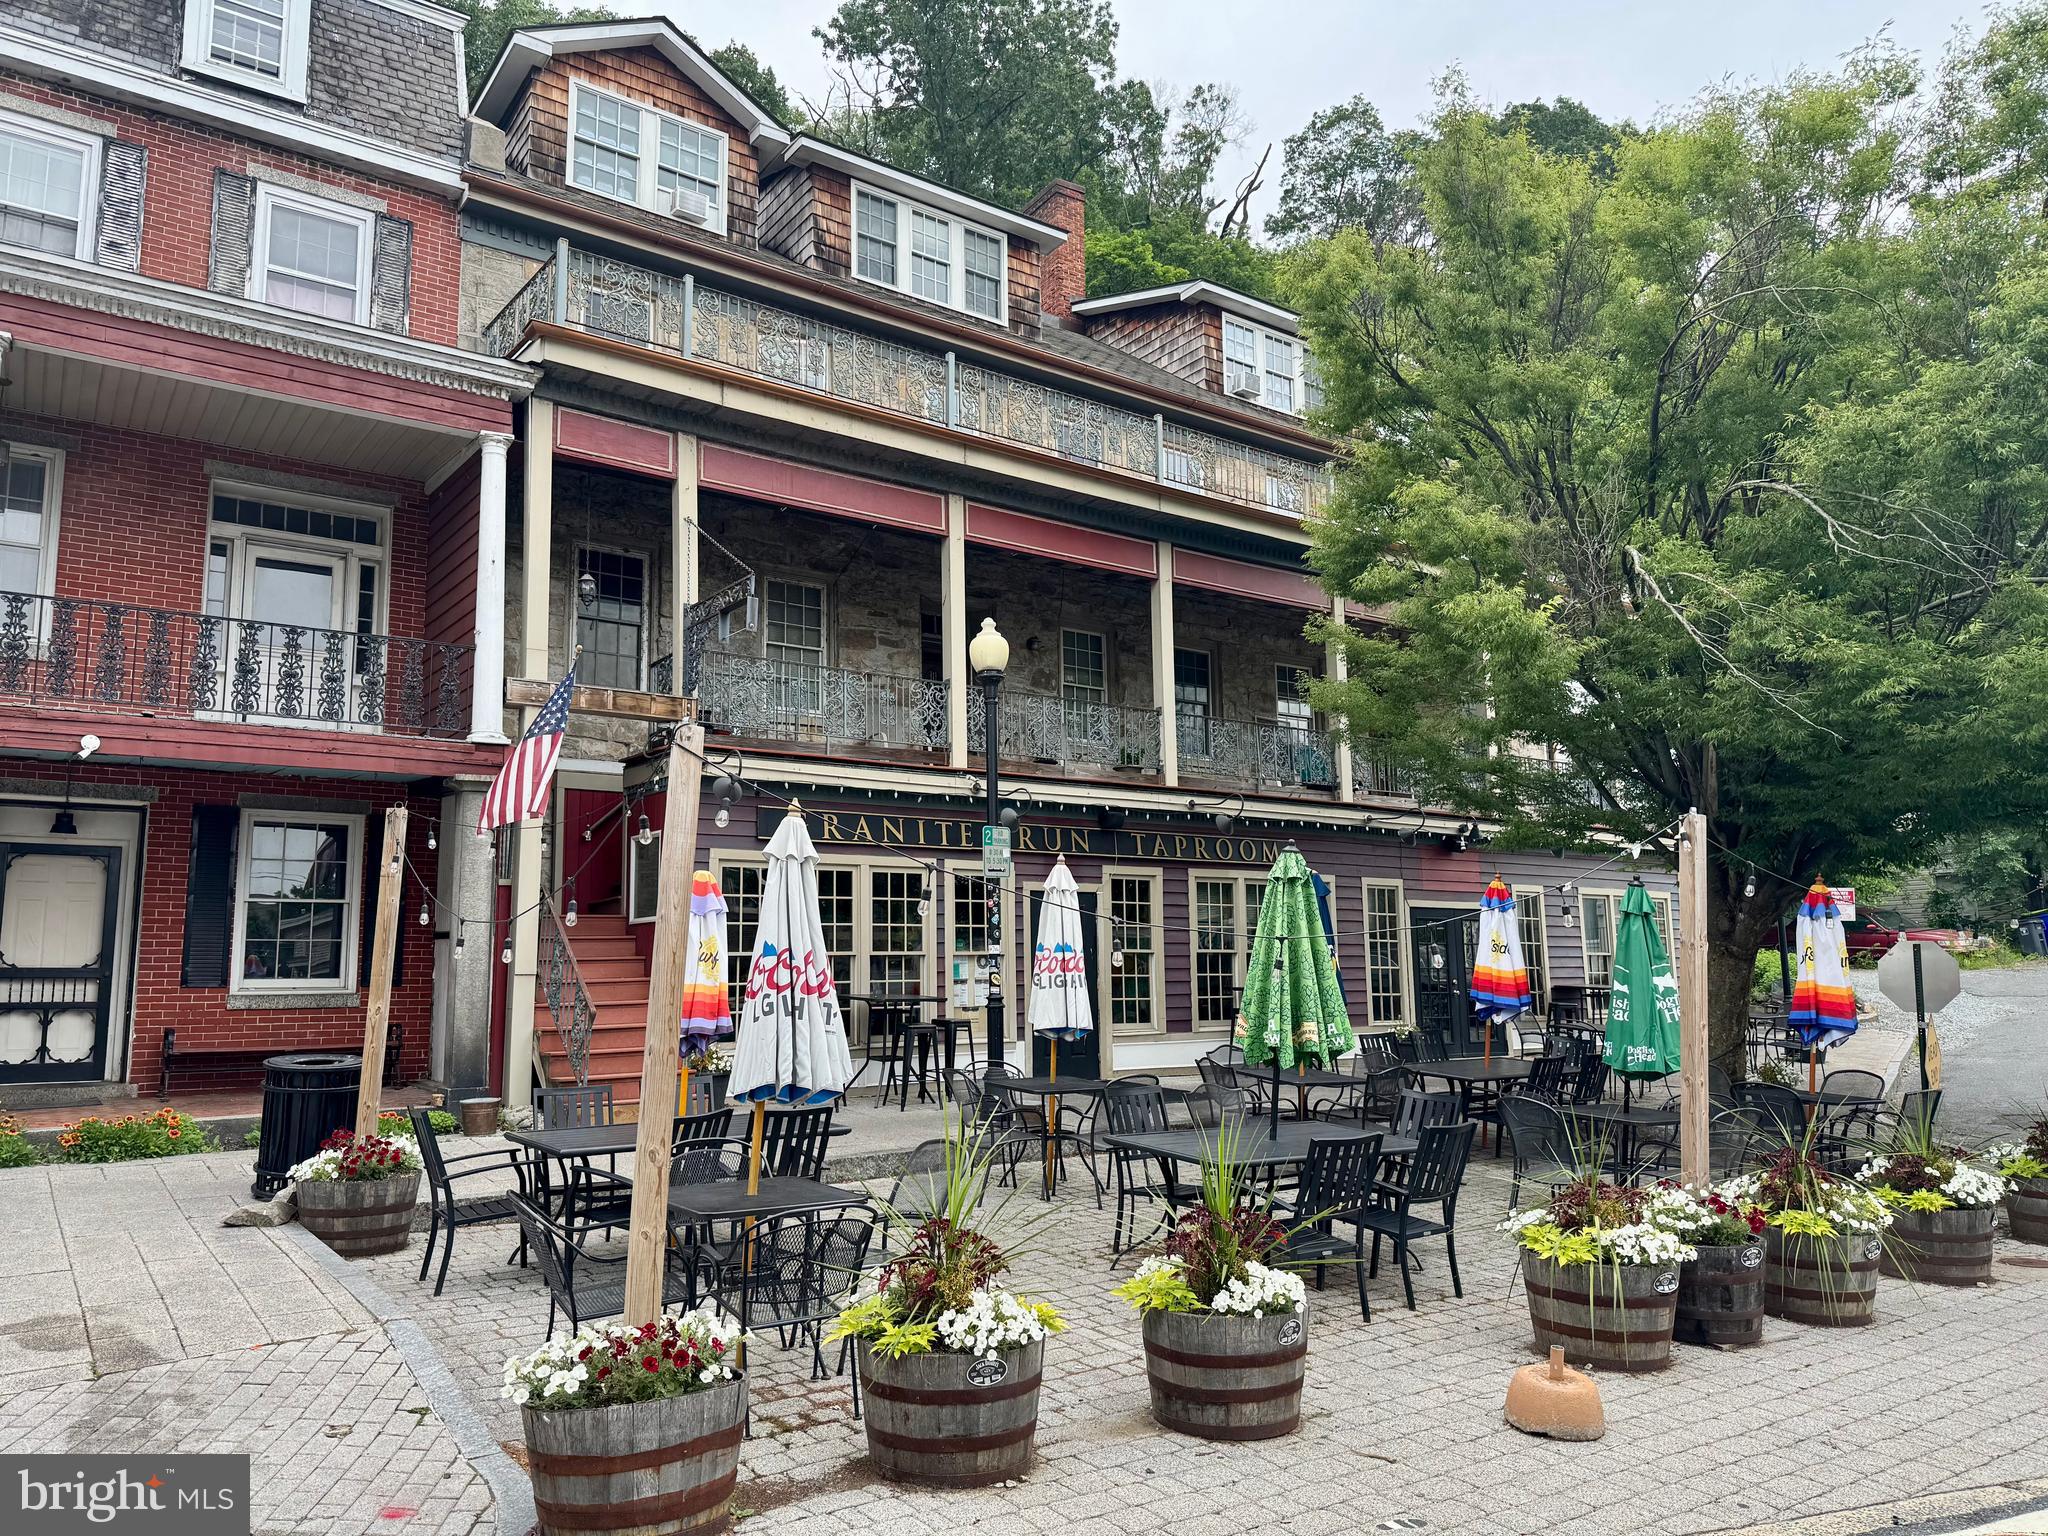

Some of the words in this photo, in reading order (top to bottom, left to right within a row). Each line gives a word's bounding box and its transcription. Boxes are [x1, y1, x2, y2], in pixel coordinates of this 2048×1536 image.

[799, 811, 974, 848] RANITE
[1019, 825, 1091, 854] RUN
[1130, 832, 1280, 863] TAPROOM
[985, 829, 992, 843] 2
